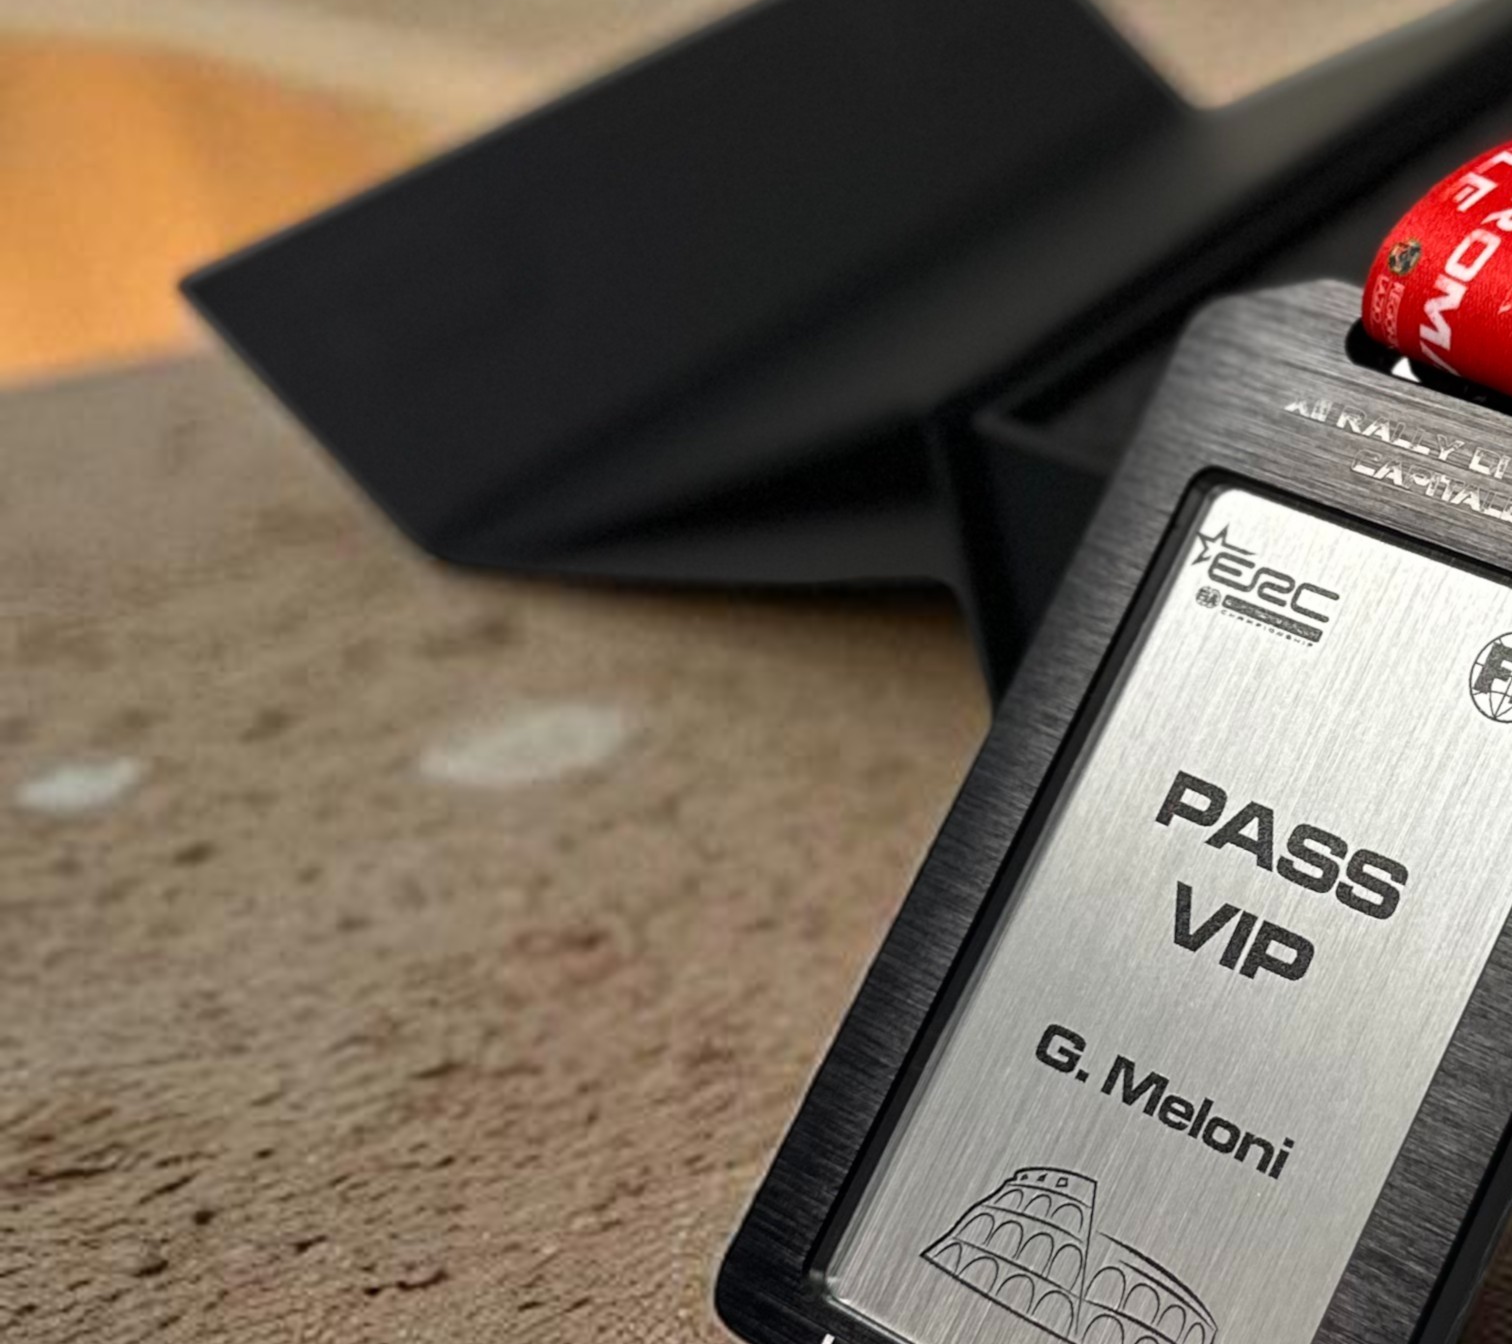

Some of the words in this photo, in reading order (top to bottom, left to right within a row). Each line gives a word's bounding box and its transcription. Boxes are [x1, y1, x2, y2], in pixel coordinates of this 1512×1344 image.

[1336, 404, 1465, 461] RALLY
[1468, 446, 1512, 479] DI
[1155, 770, 1409, 920] PASS
[1173, 881, 1315, 982] VIP
[1035, 1024, 1089, 1083] G.
[1100, 1054, 1295, 1179] Meloni
